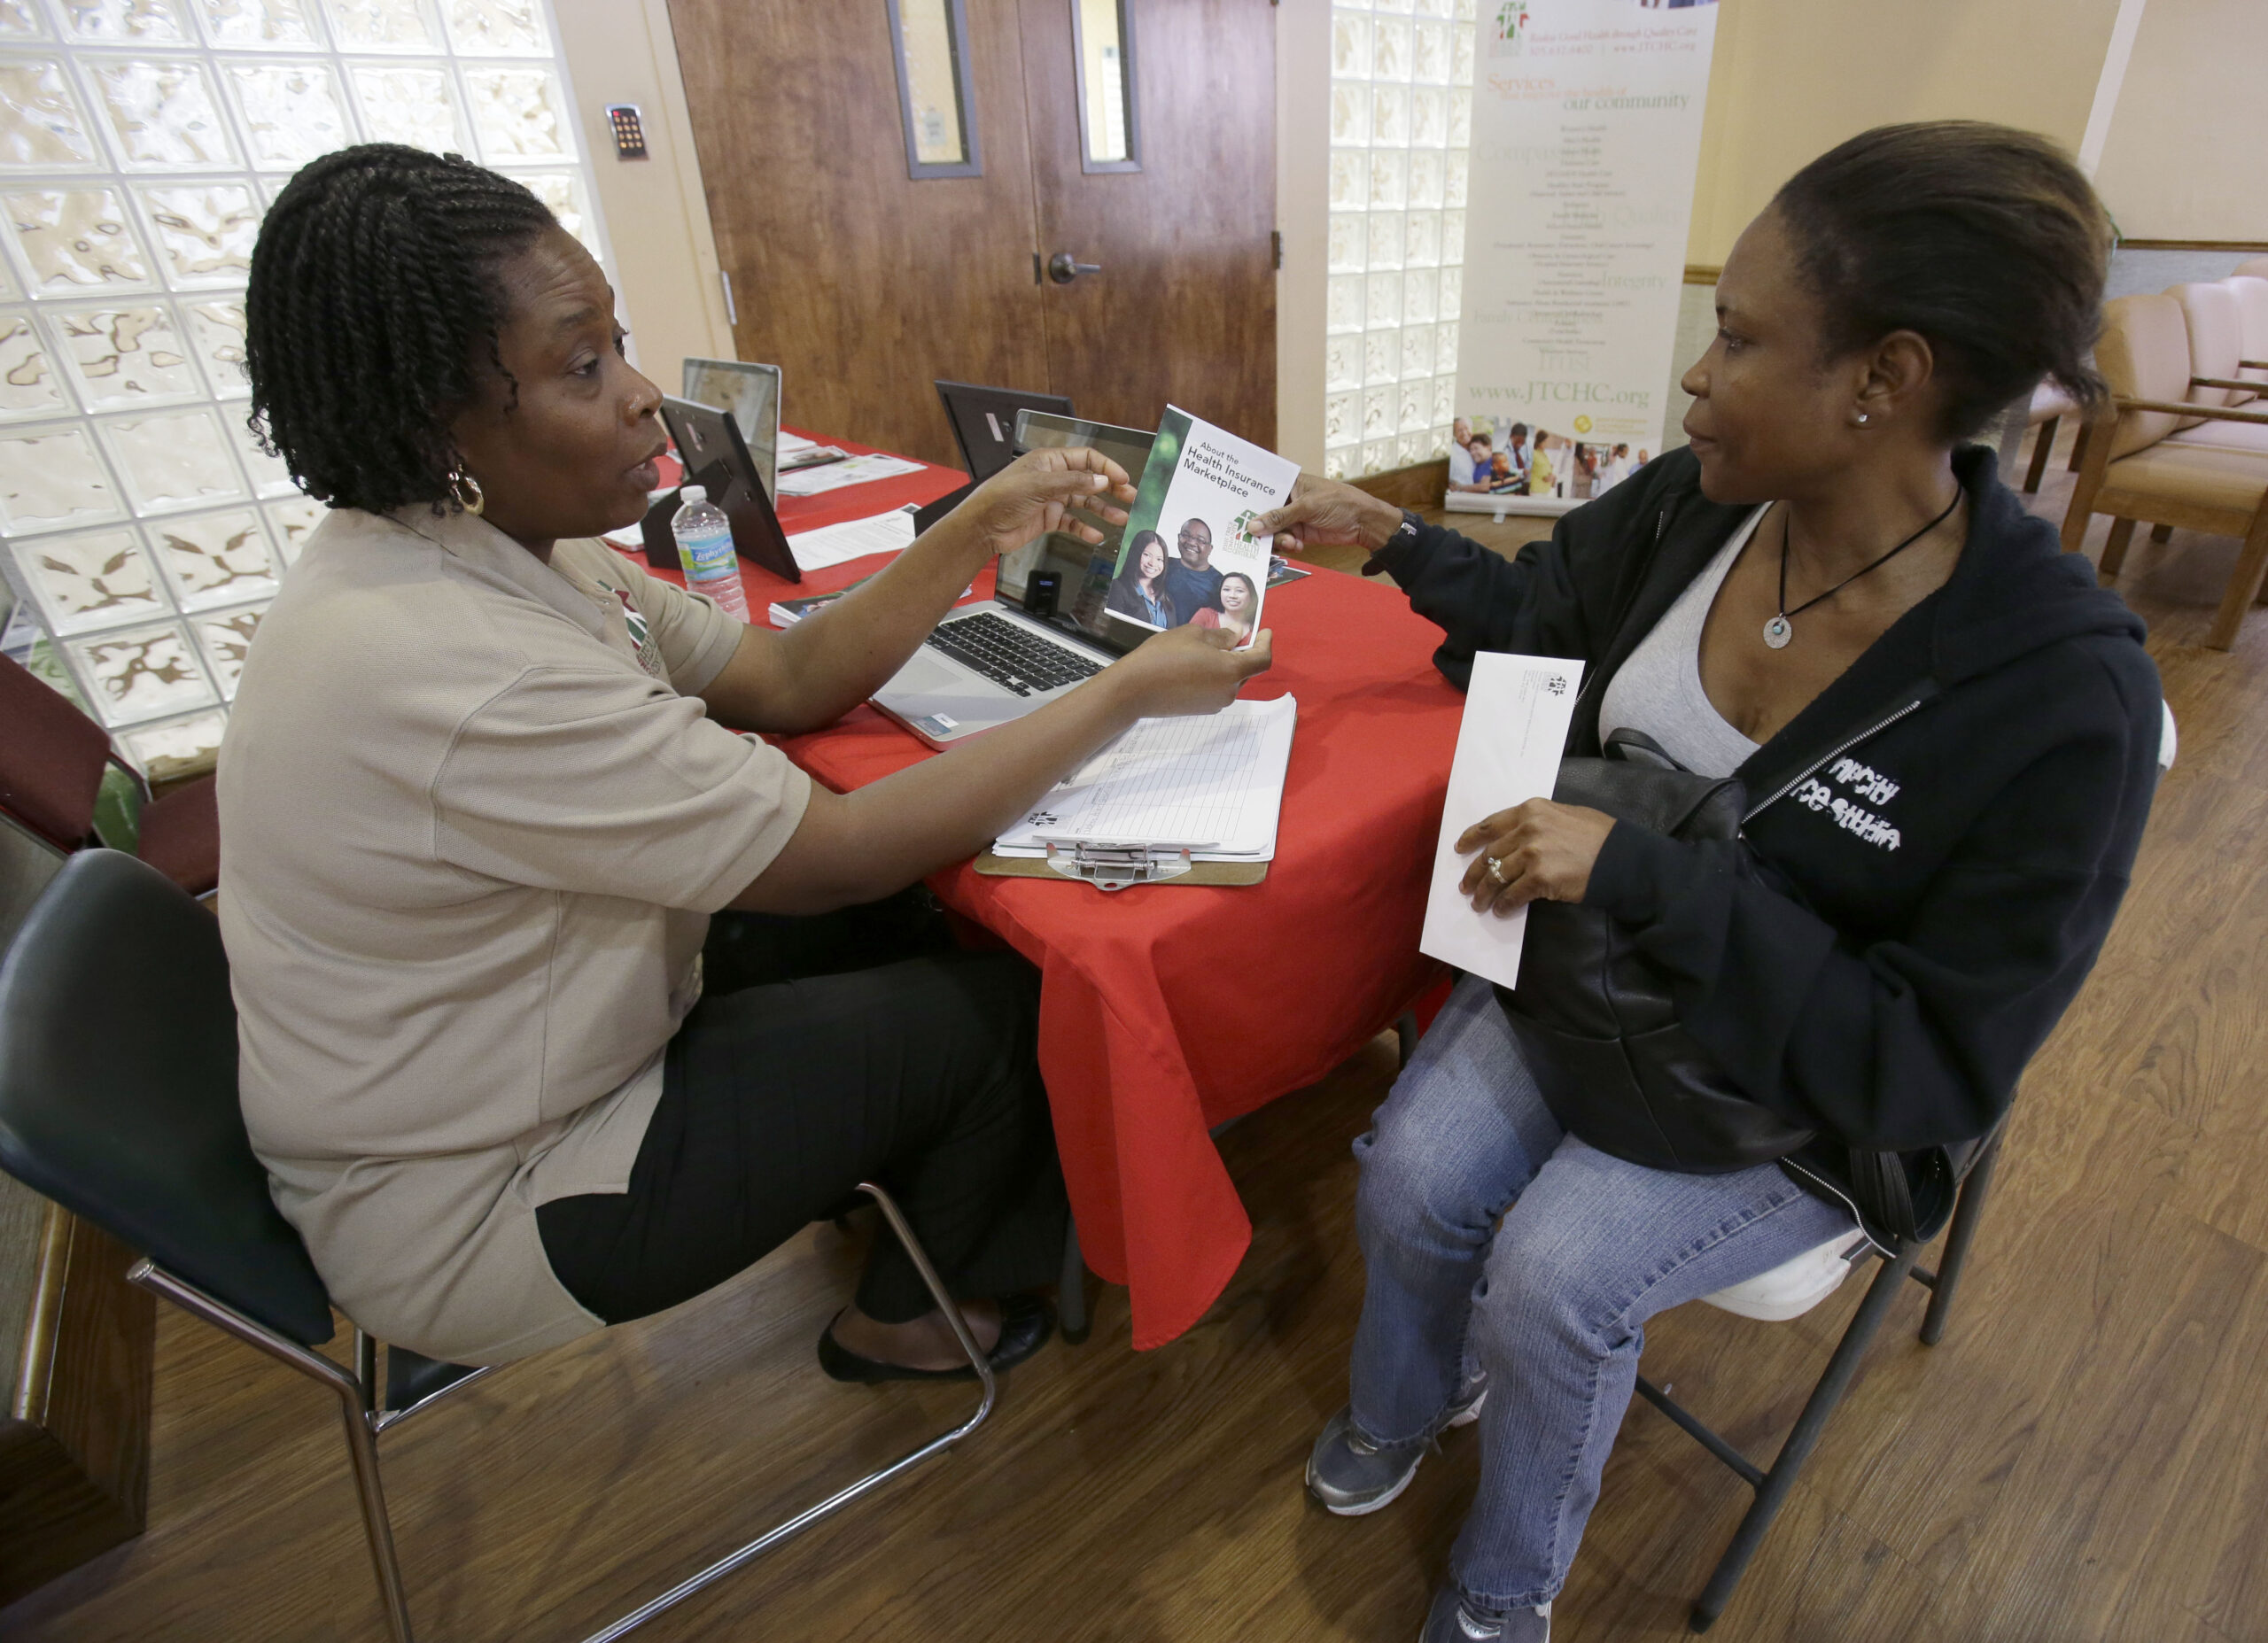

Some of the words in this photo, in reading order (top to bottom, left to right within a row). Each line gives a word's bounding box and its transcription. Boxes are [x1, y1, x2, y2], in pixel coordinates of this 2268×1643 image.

[1487, 72, 1556, 92] Services
[1563, 97, 1592, 112] our
[1594, 90, 1691, 112] community
[1469, 381, 1651, 408] www.JTCHC.org
[1200, 441, 1225, 457] About
[1225, 453, 1239, 466] the
[1184, 458, 1249, 499] Marketplace
[1187, 446, 1223, 471] Health
[1224, 463, 1276, 497] Insurance
